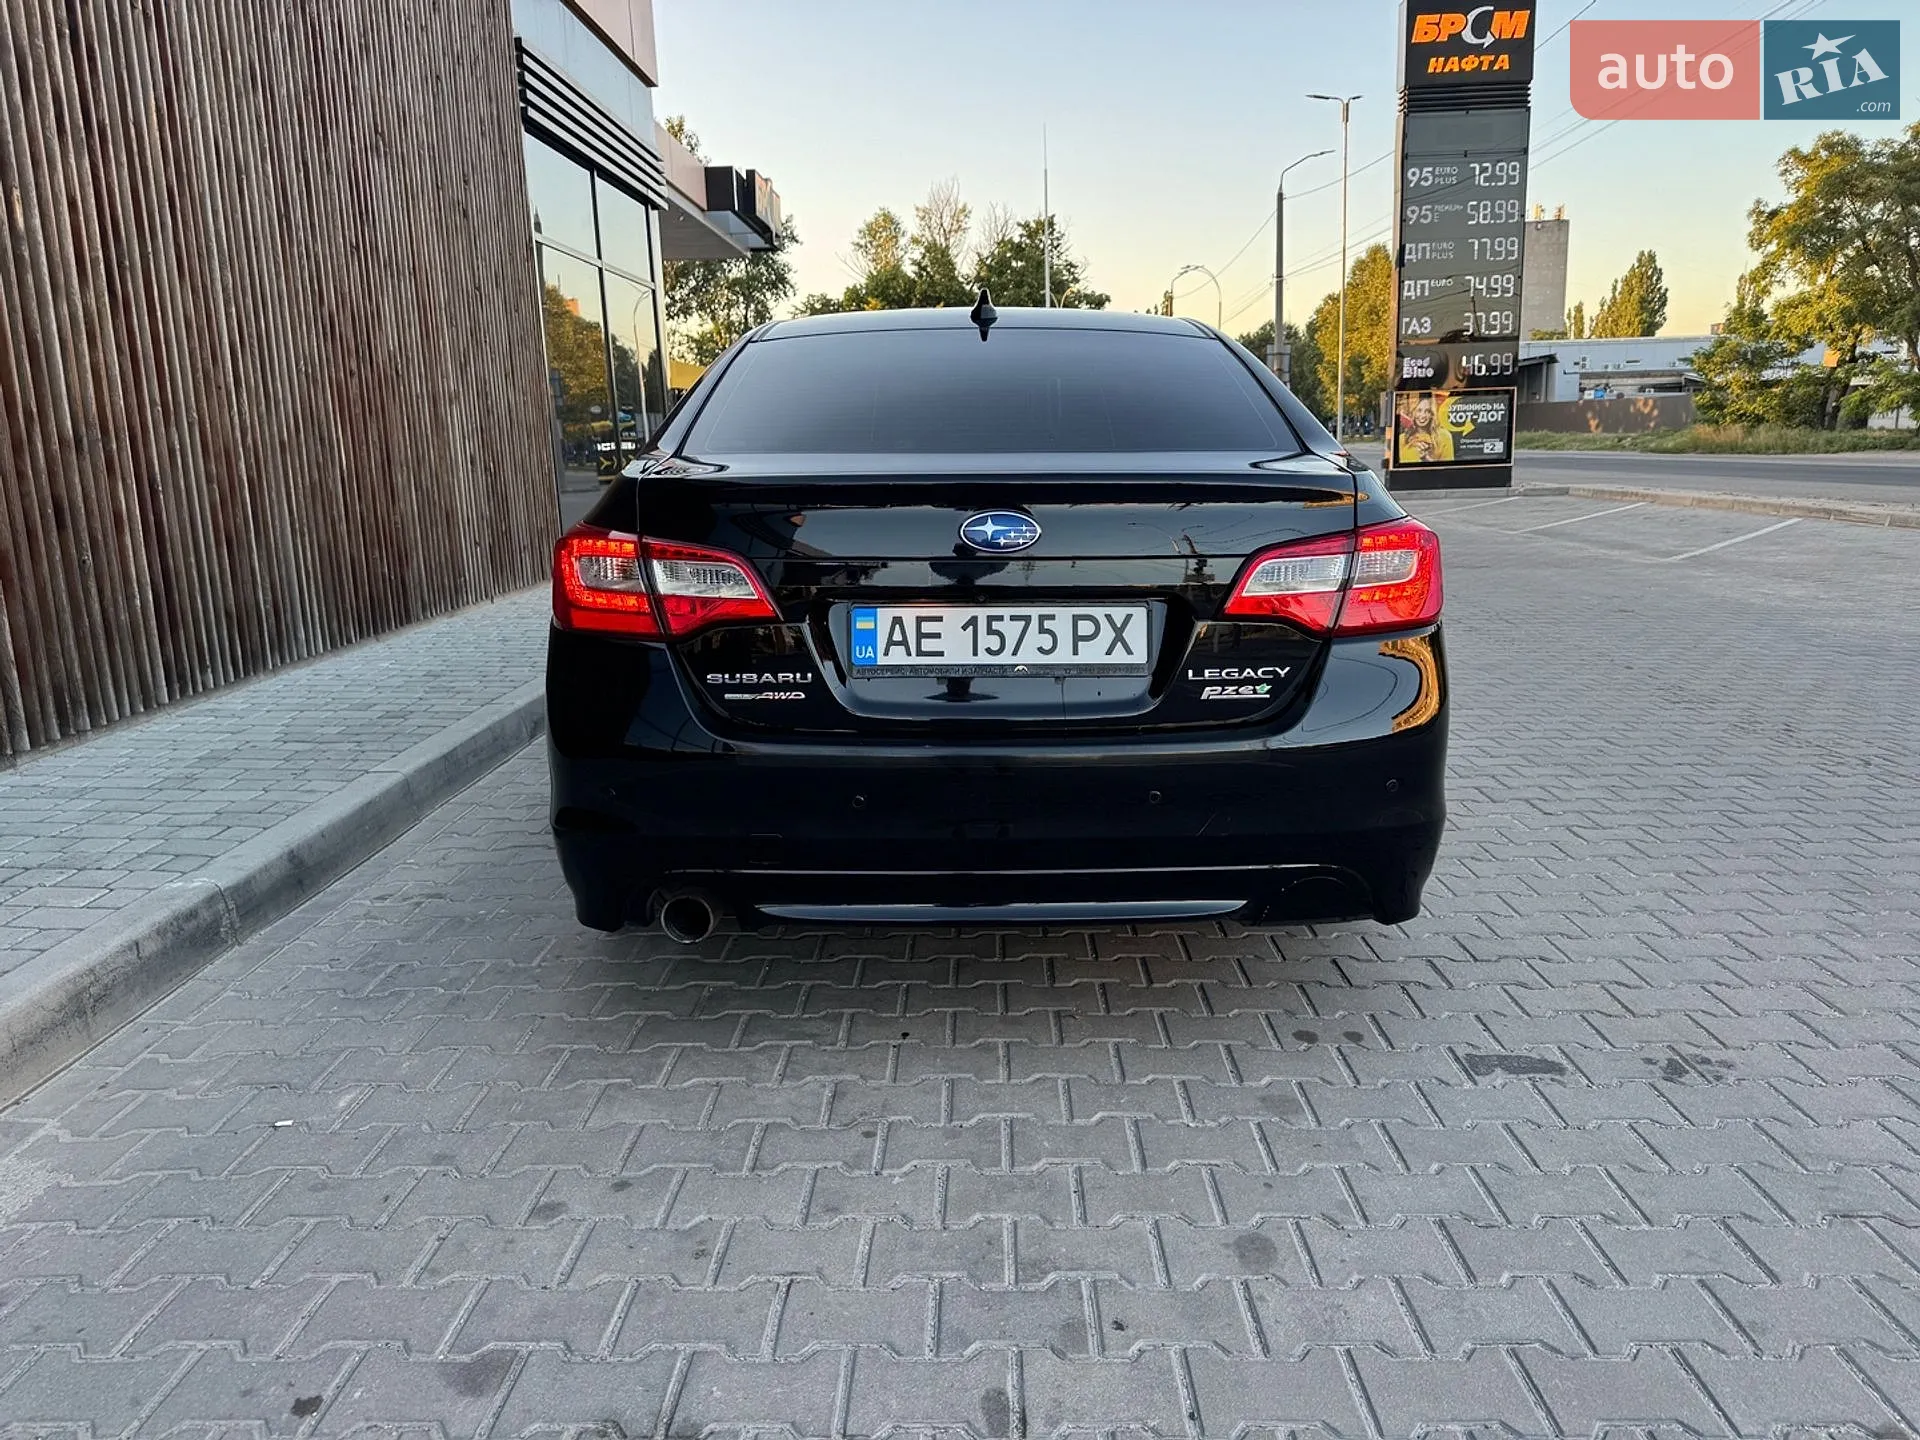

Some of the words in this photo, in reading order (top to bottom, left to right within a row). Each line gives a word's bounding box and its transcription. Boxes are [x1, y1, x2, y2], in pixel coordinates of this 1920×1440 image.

[1411, 6, 1531, 49] БРСМ
[1427, 54, 1510, 73] НАФТА
[1407, 167, 1433, 187] 95
[1434, 166, 1459, 175] EURO
[1470, 162, 1520, 187] 72.99
[1434, 176, 1458, 185] PLUS
[1406, 204, 1432, 225] 95
[1467, 200, 1519, 225] 58.99
[1404, 243, 1431, 263] ДП
[1431, 241, 1455, 250] EURO
[1468, 237, 1519, 261] 77.99
[1431, 250, 1455, 259] PLUS
[1402, 279, 1430, 300] ДП
[1430, 278, 1454, 287] EURO
[1465, 274, 1515, 298] 74.99
[1402, 317, 1432, 334] ГАЗ
[1463, 311, 1513, 336] 37.99
[1461, 352, 1514, 376] 46.99
[1448, 410, 1506, 423] ХОТ-ДОГ
[1493, 402, 1506, 410] НА
[883, 615, 945, 657] AE
[960, 613, 1059, 657] 1575
[1071, 613, 1134, 656] PX
[856, 645, 875, 659] UA
[707, 672, 812, 684] SUBARU
[1187, 666, 1291, 680] LEGACY
